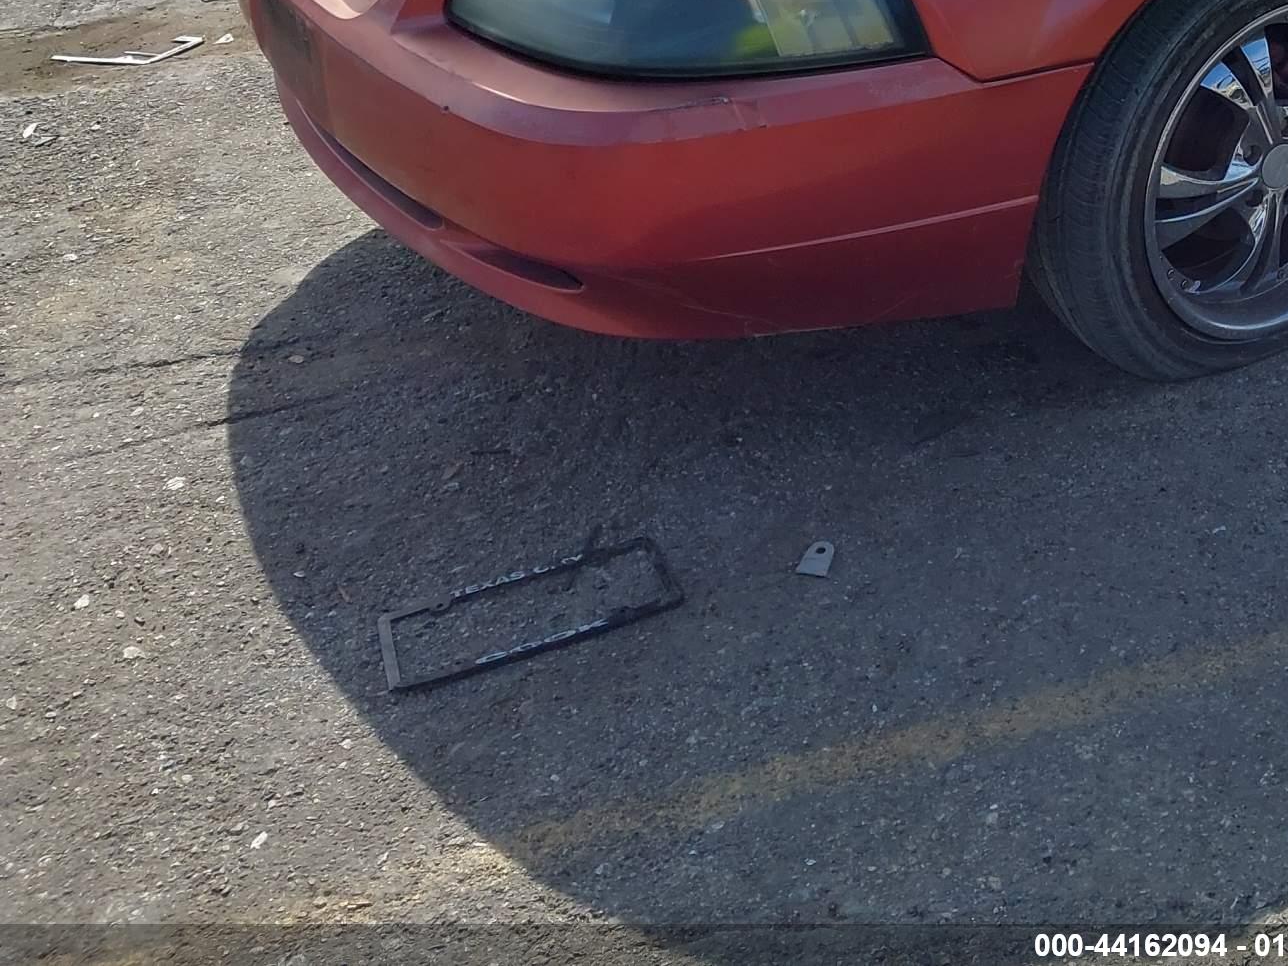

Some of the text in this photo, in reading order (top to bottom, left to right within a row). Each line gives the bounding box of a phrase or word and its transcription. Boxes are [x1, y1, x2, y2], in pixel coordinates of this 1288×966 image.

[450, 553, 583, 597] TEXAS CY
[475, 618, 609, 664] COOK
